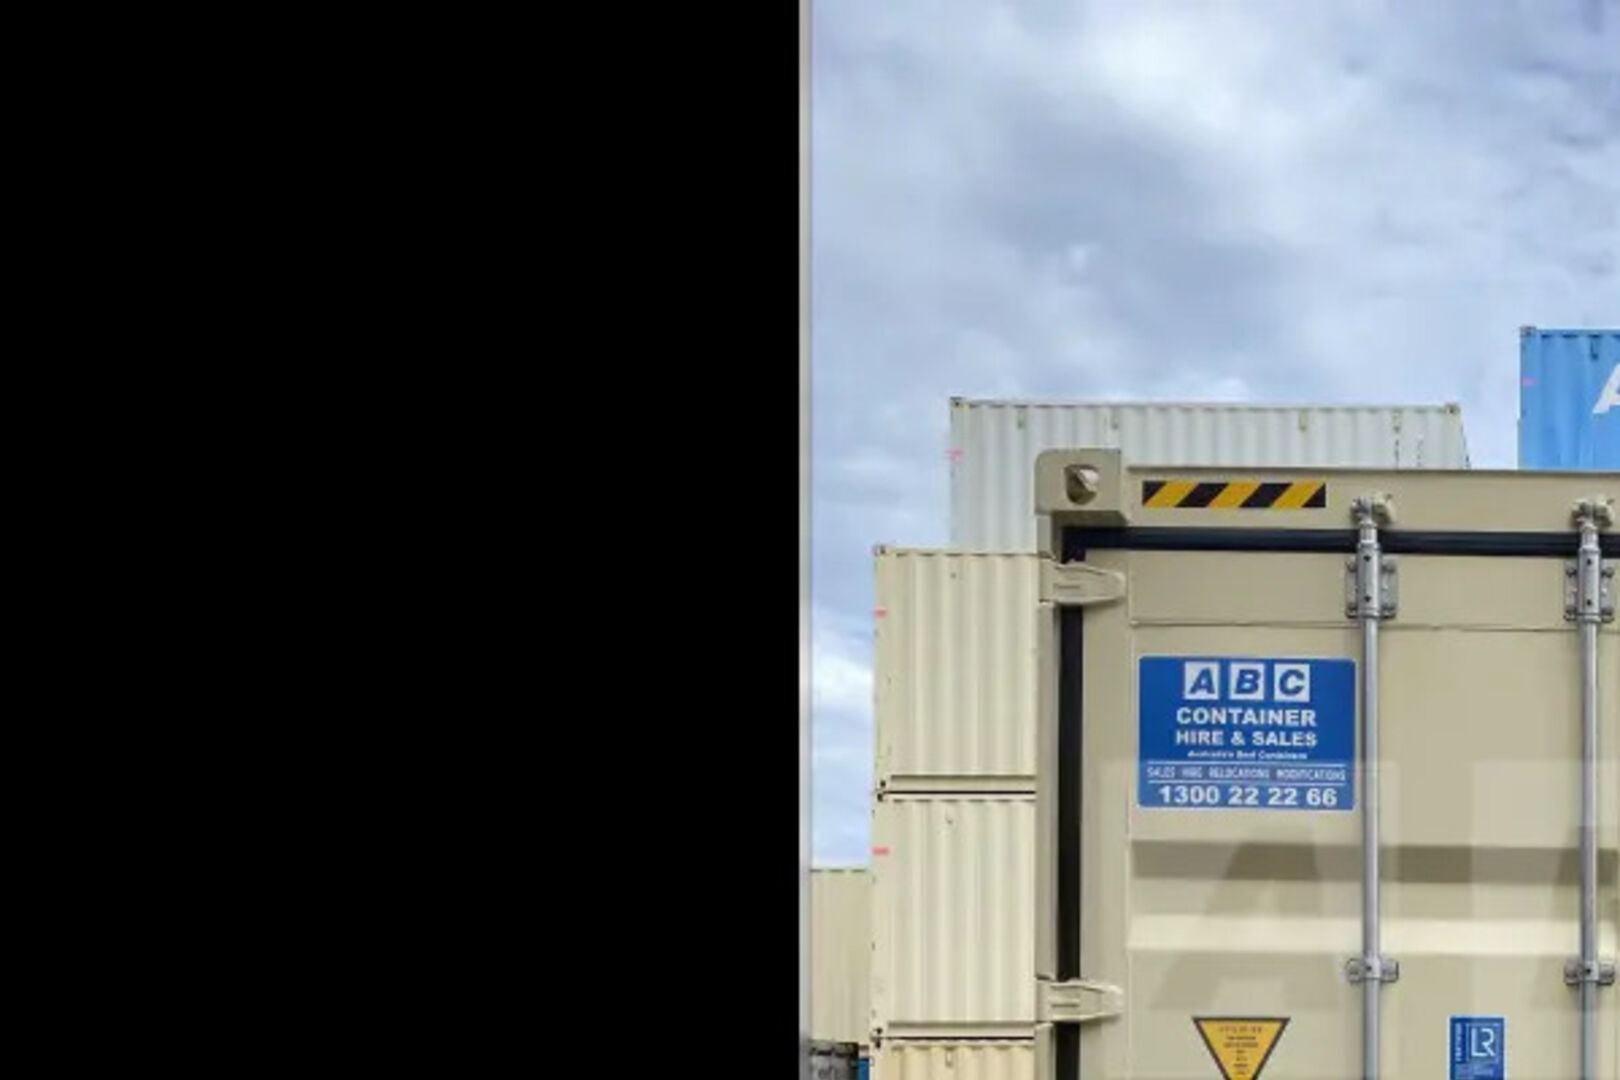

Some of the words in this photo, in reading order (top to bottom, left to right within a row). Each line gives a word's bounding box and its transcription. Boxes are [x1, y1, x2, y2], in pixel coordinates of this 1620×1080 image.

[1176, 707, 1317, 727] CONTAINER
[1176, 730, 1224, 746] HIRE
[1230, 731, 1246, 746] &
[1252, 731, 1318, 748] SALES
[1158, 785, 1220, 805] 1300
[1228, 786, 1260, 806] 22
[1268, 786, 1298, 806] 22
[1306, 787, 1338, 807] 66
[1471, 1028, 1496, 1057] LR
